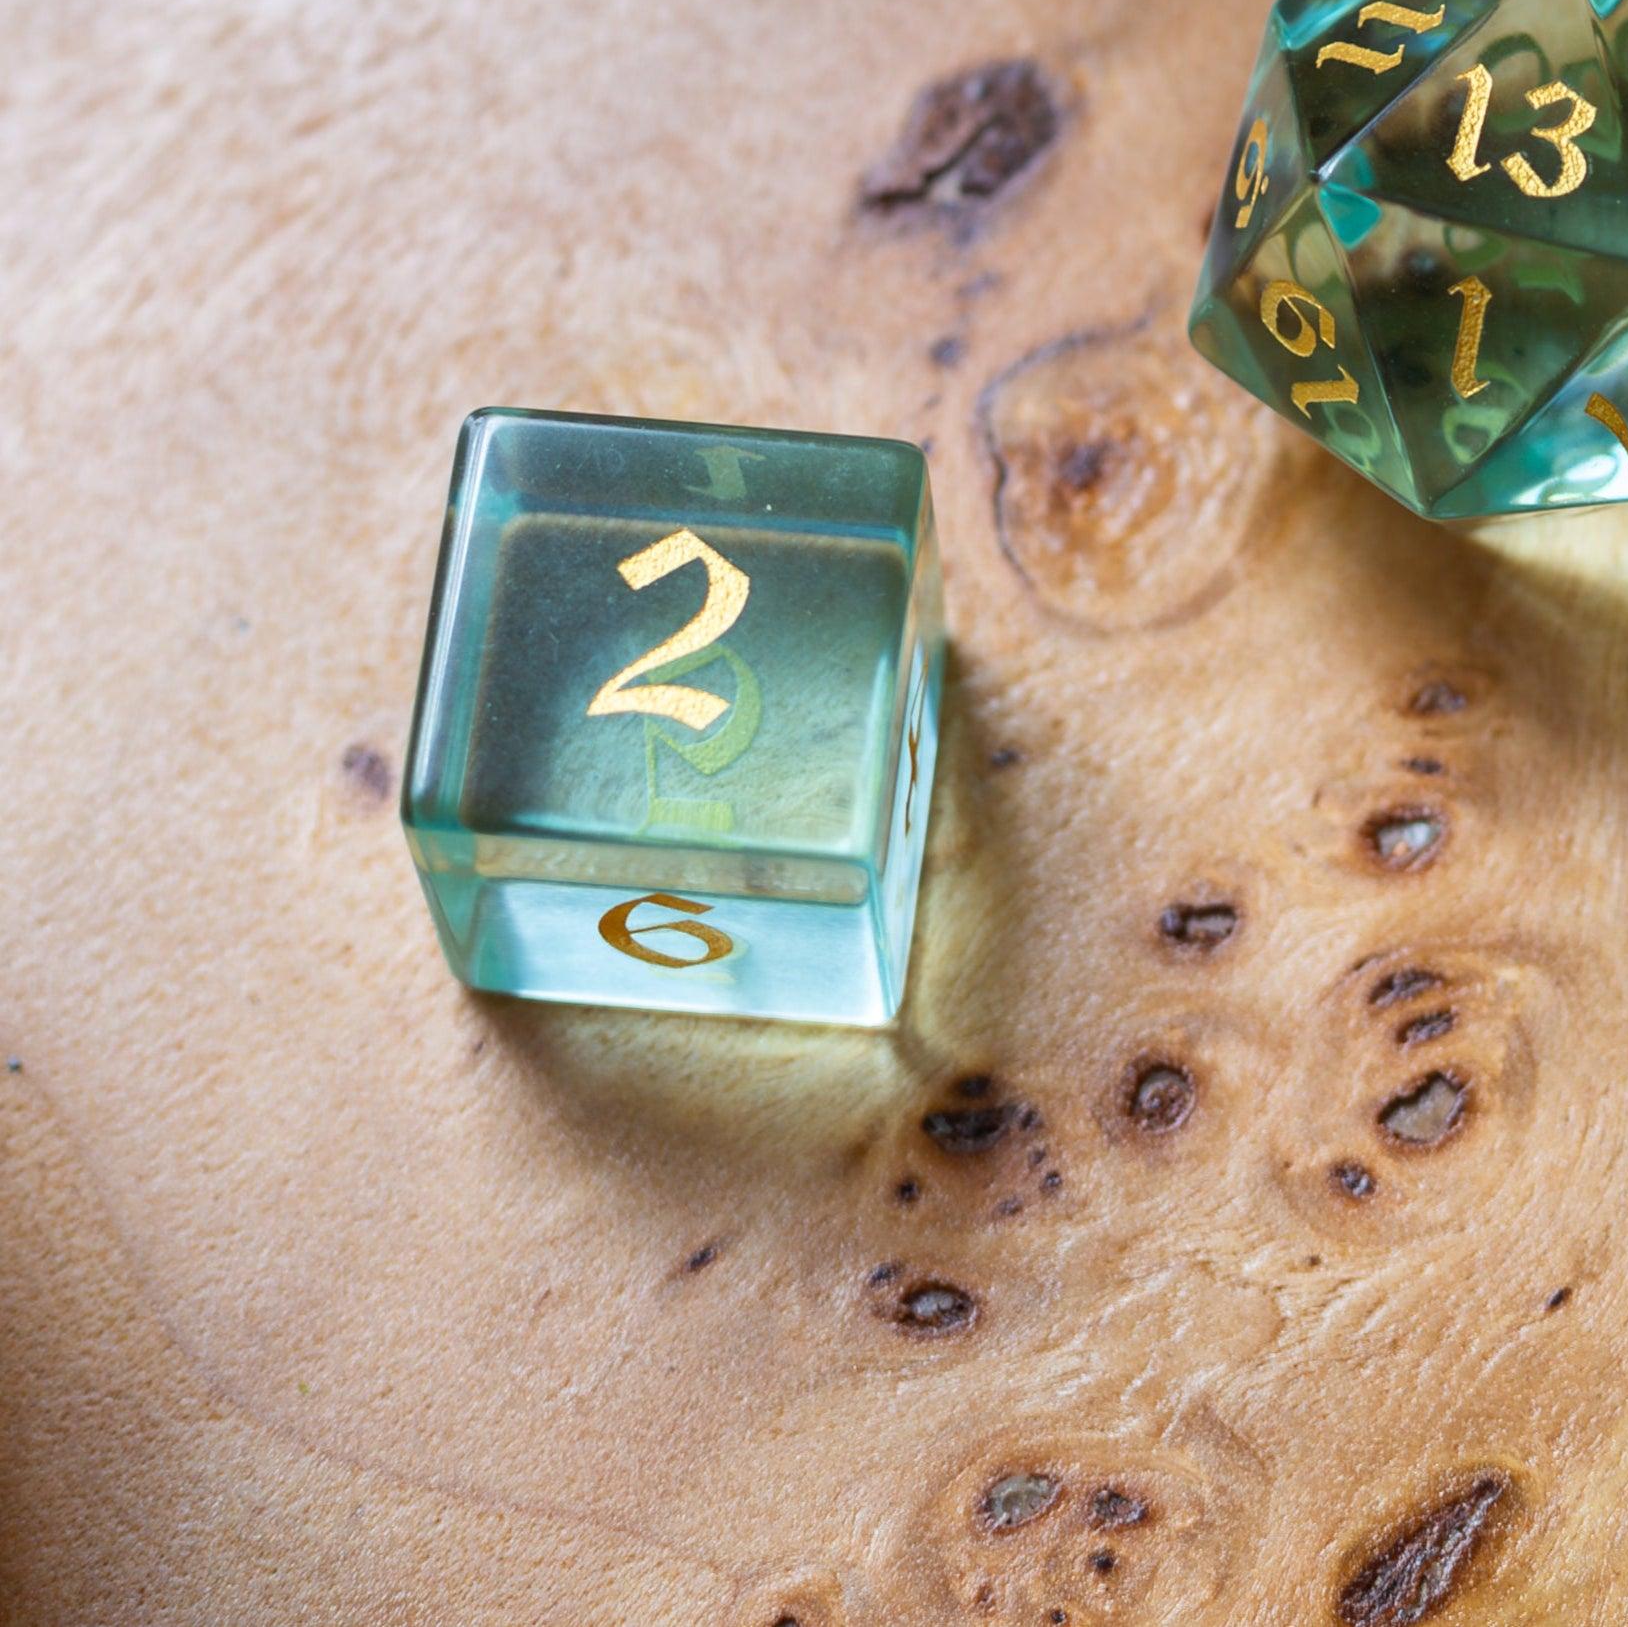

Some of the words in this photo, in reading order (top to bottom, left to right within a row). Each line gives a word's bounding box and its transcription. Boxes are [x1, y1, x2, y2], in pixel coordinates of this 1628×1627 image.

[1316, 0, 1446, 75] 11
[1446, 64, 1600, 199] 13
[1448, 276, 1494, 400] 1
[586, 527, 752, 732] 2
[597, 892, 735, 970] 6
